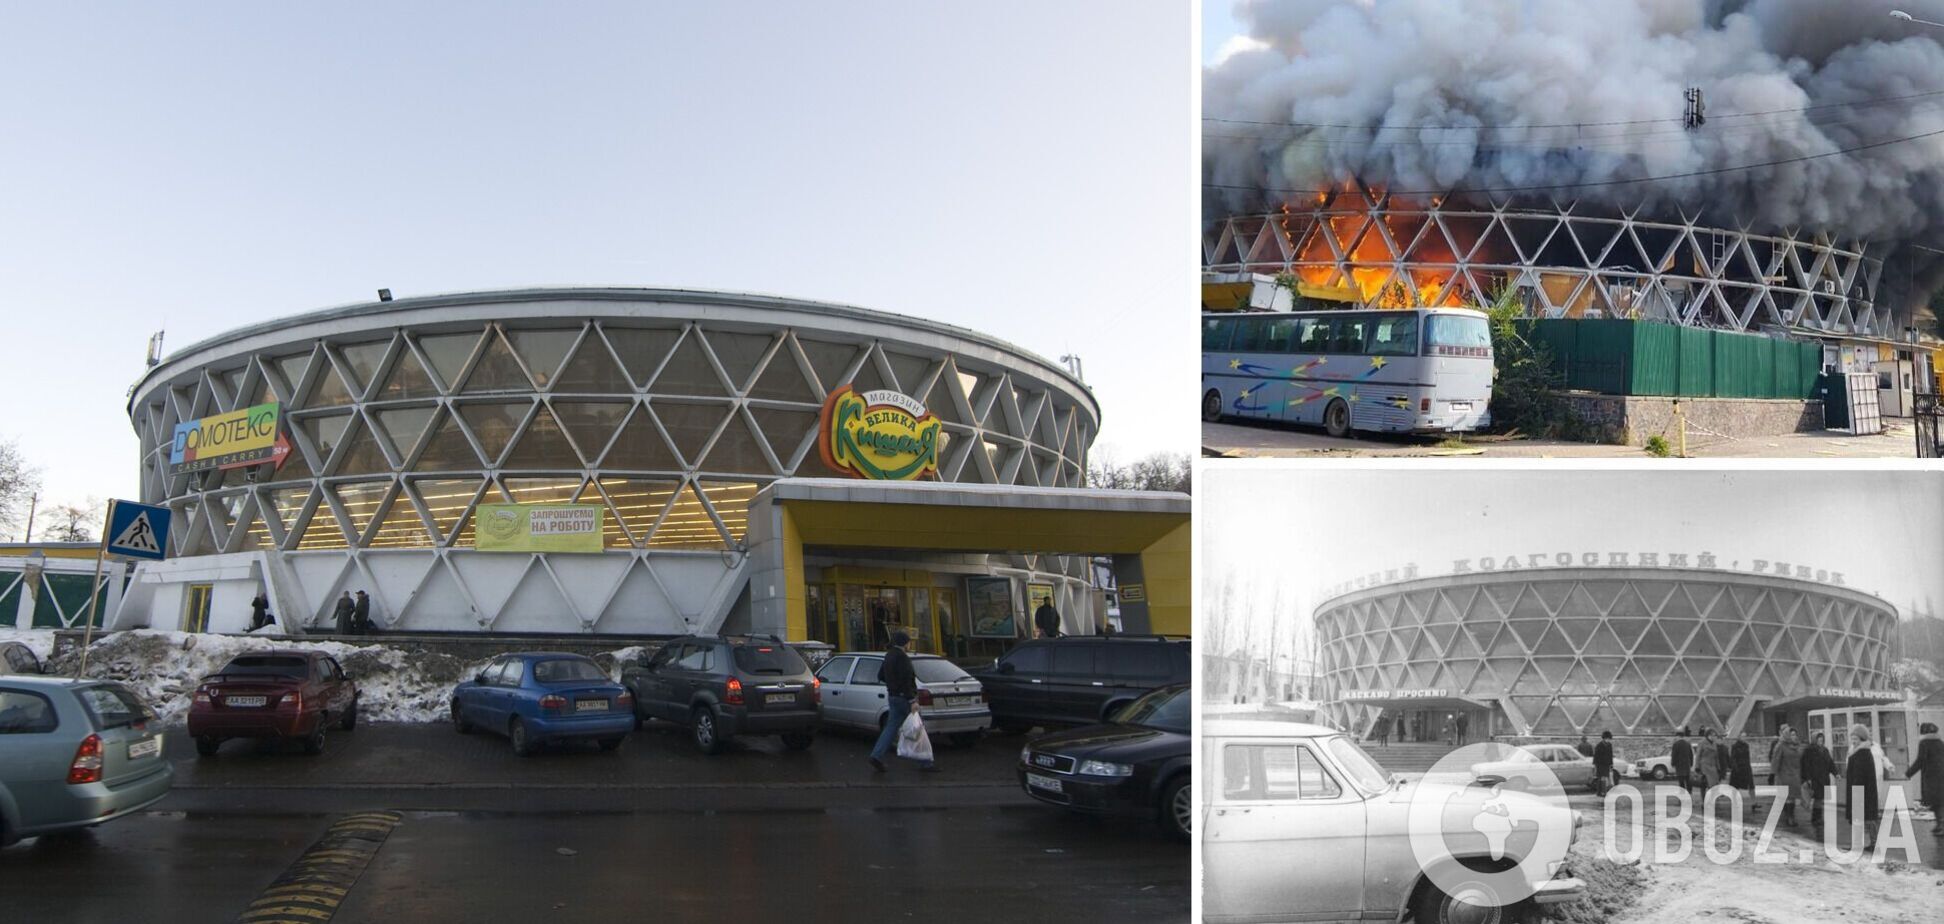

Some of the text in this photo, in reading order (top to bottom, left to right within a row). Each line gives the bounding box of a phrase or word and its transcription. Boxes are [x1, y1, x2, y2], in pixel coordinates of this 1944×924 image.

[866, 412, 916, 432] ВЕЛИКА
[177, 460, 206, 472] CASH
[223, 450, 264, 464] CARRY
[531, 509, 593, 520] ЗАПРОШУЄМО
[531, 520, 594, 532] НА РОБОТУ
[1453, 552, 1716, 573] КОЛГОСПНИЙ
[1753, 559, 1846, 584] РИНОК
